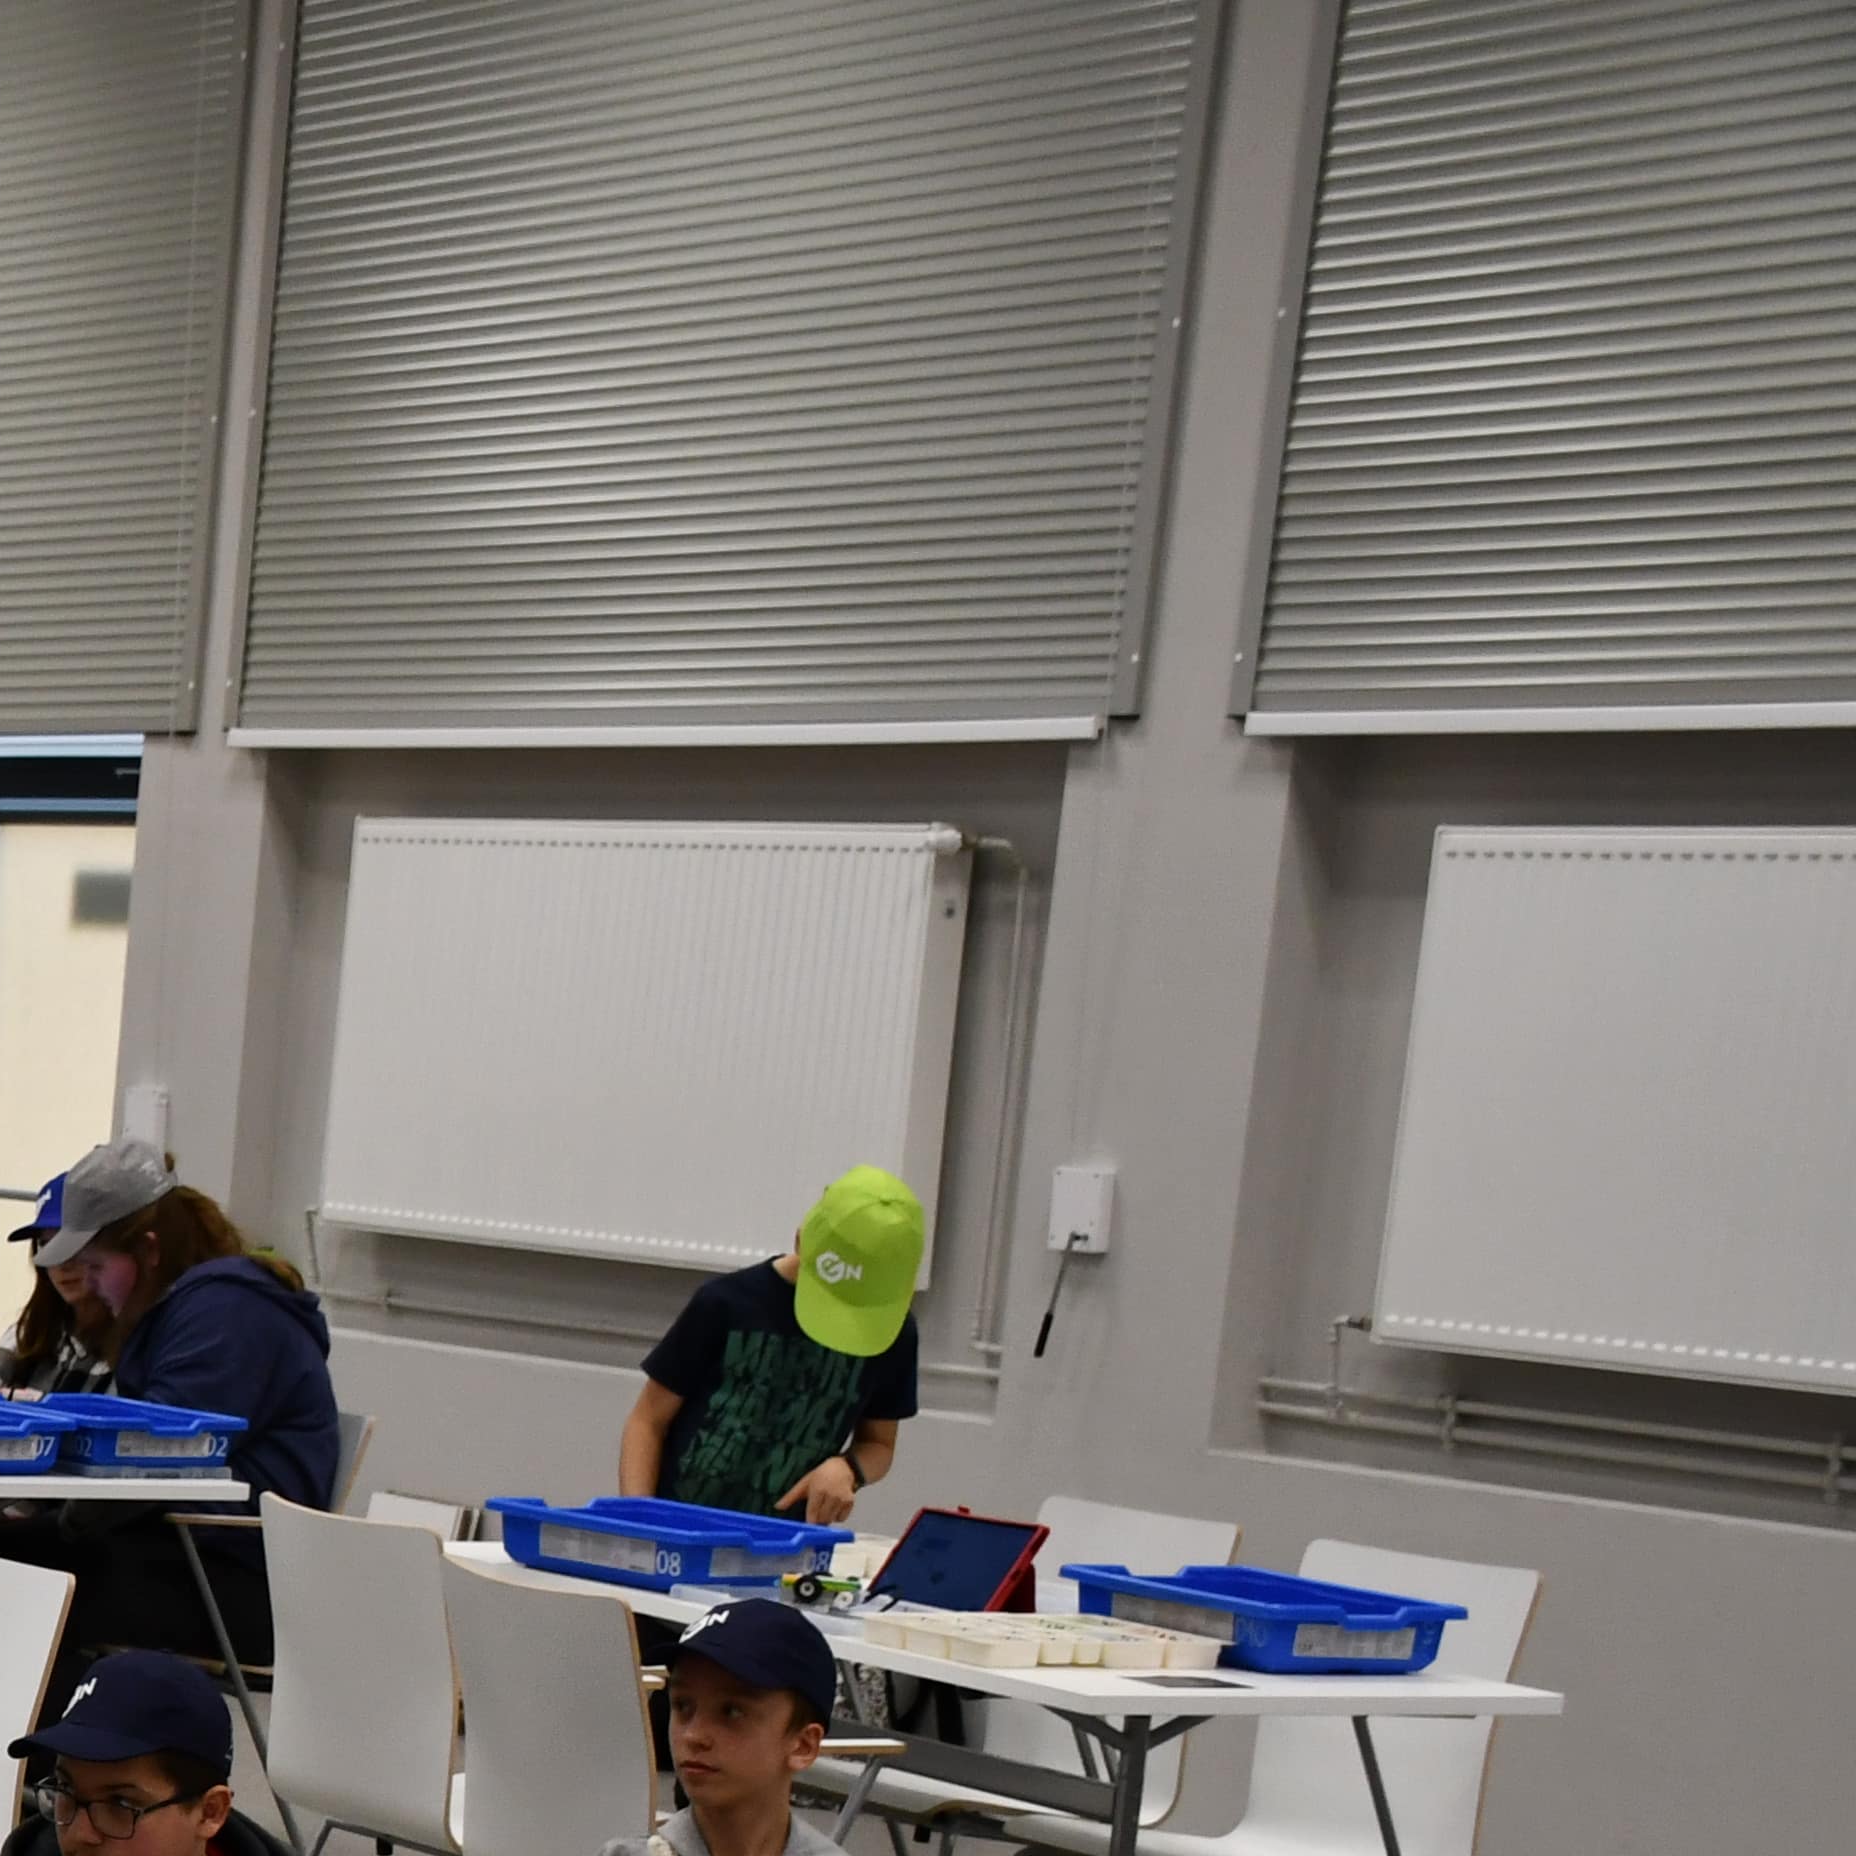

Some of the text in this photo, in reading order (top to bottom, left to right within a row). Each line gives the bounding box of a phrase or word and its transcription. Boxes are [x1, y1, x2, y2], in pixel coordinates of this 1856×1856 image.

[33, 1435, 55, 1458] 07
[206, 1435, 228, 1458] 02
[655, 1550, 682, 1578] 08
[804, 1550, 830, 1576] 08
